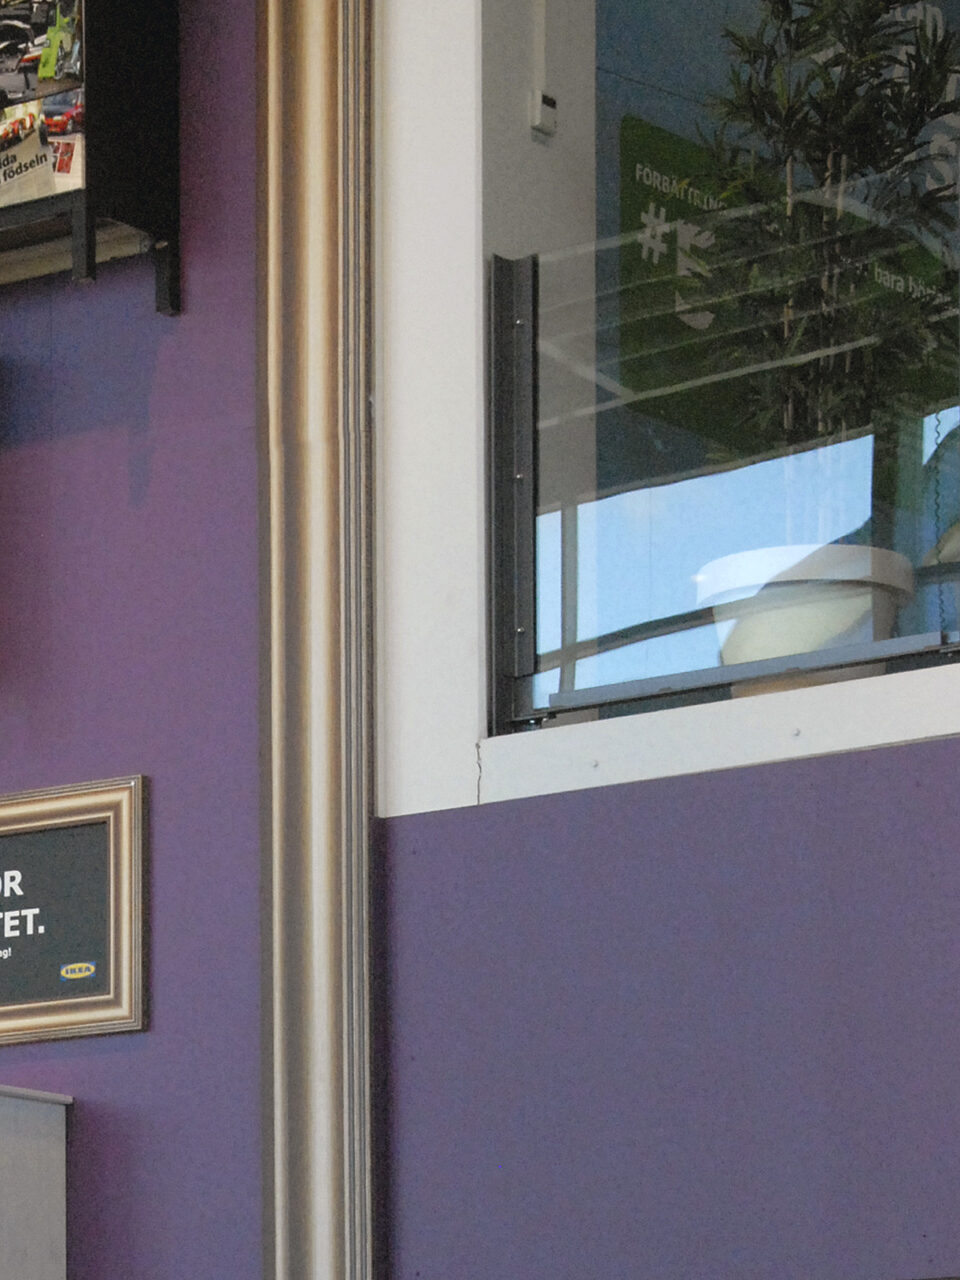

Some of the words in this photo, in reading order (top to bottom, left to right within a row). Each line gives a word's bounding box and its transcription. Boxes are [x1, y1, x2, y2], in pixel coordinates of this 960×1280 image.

[3, 153, 48, 181] födseln
[636, 163, 728, 210] FÖRBÄTTRIN
[63, 964, 93, 977] IKEA
